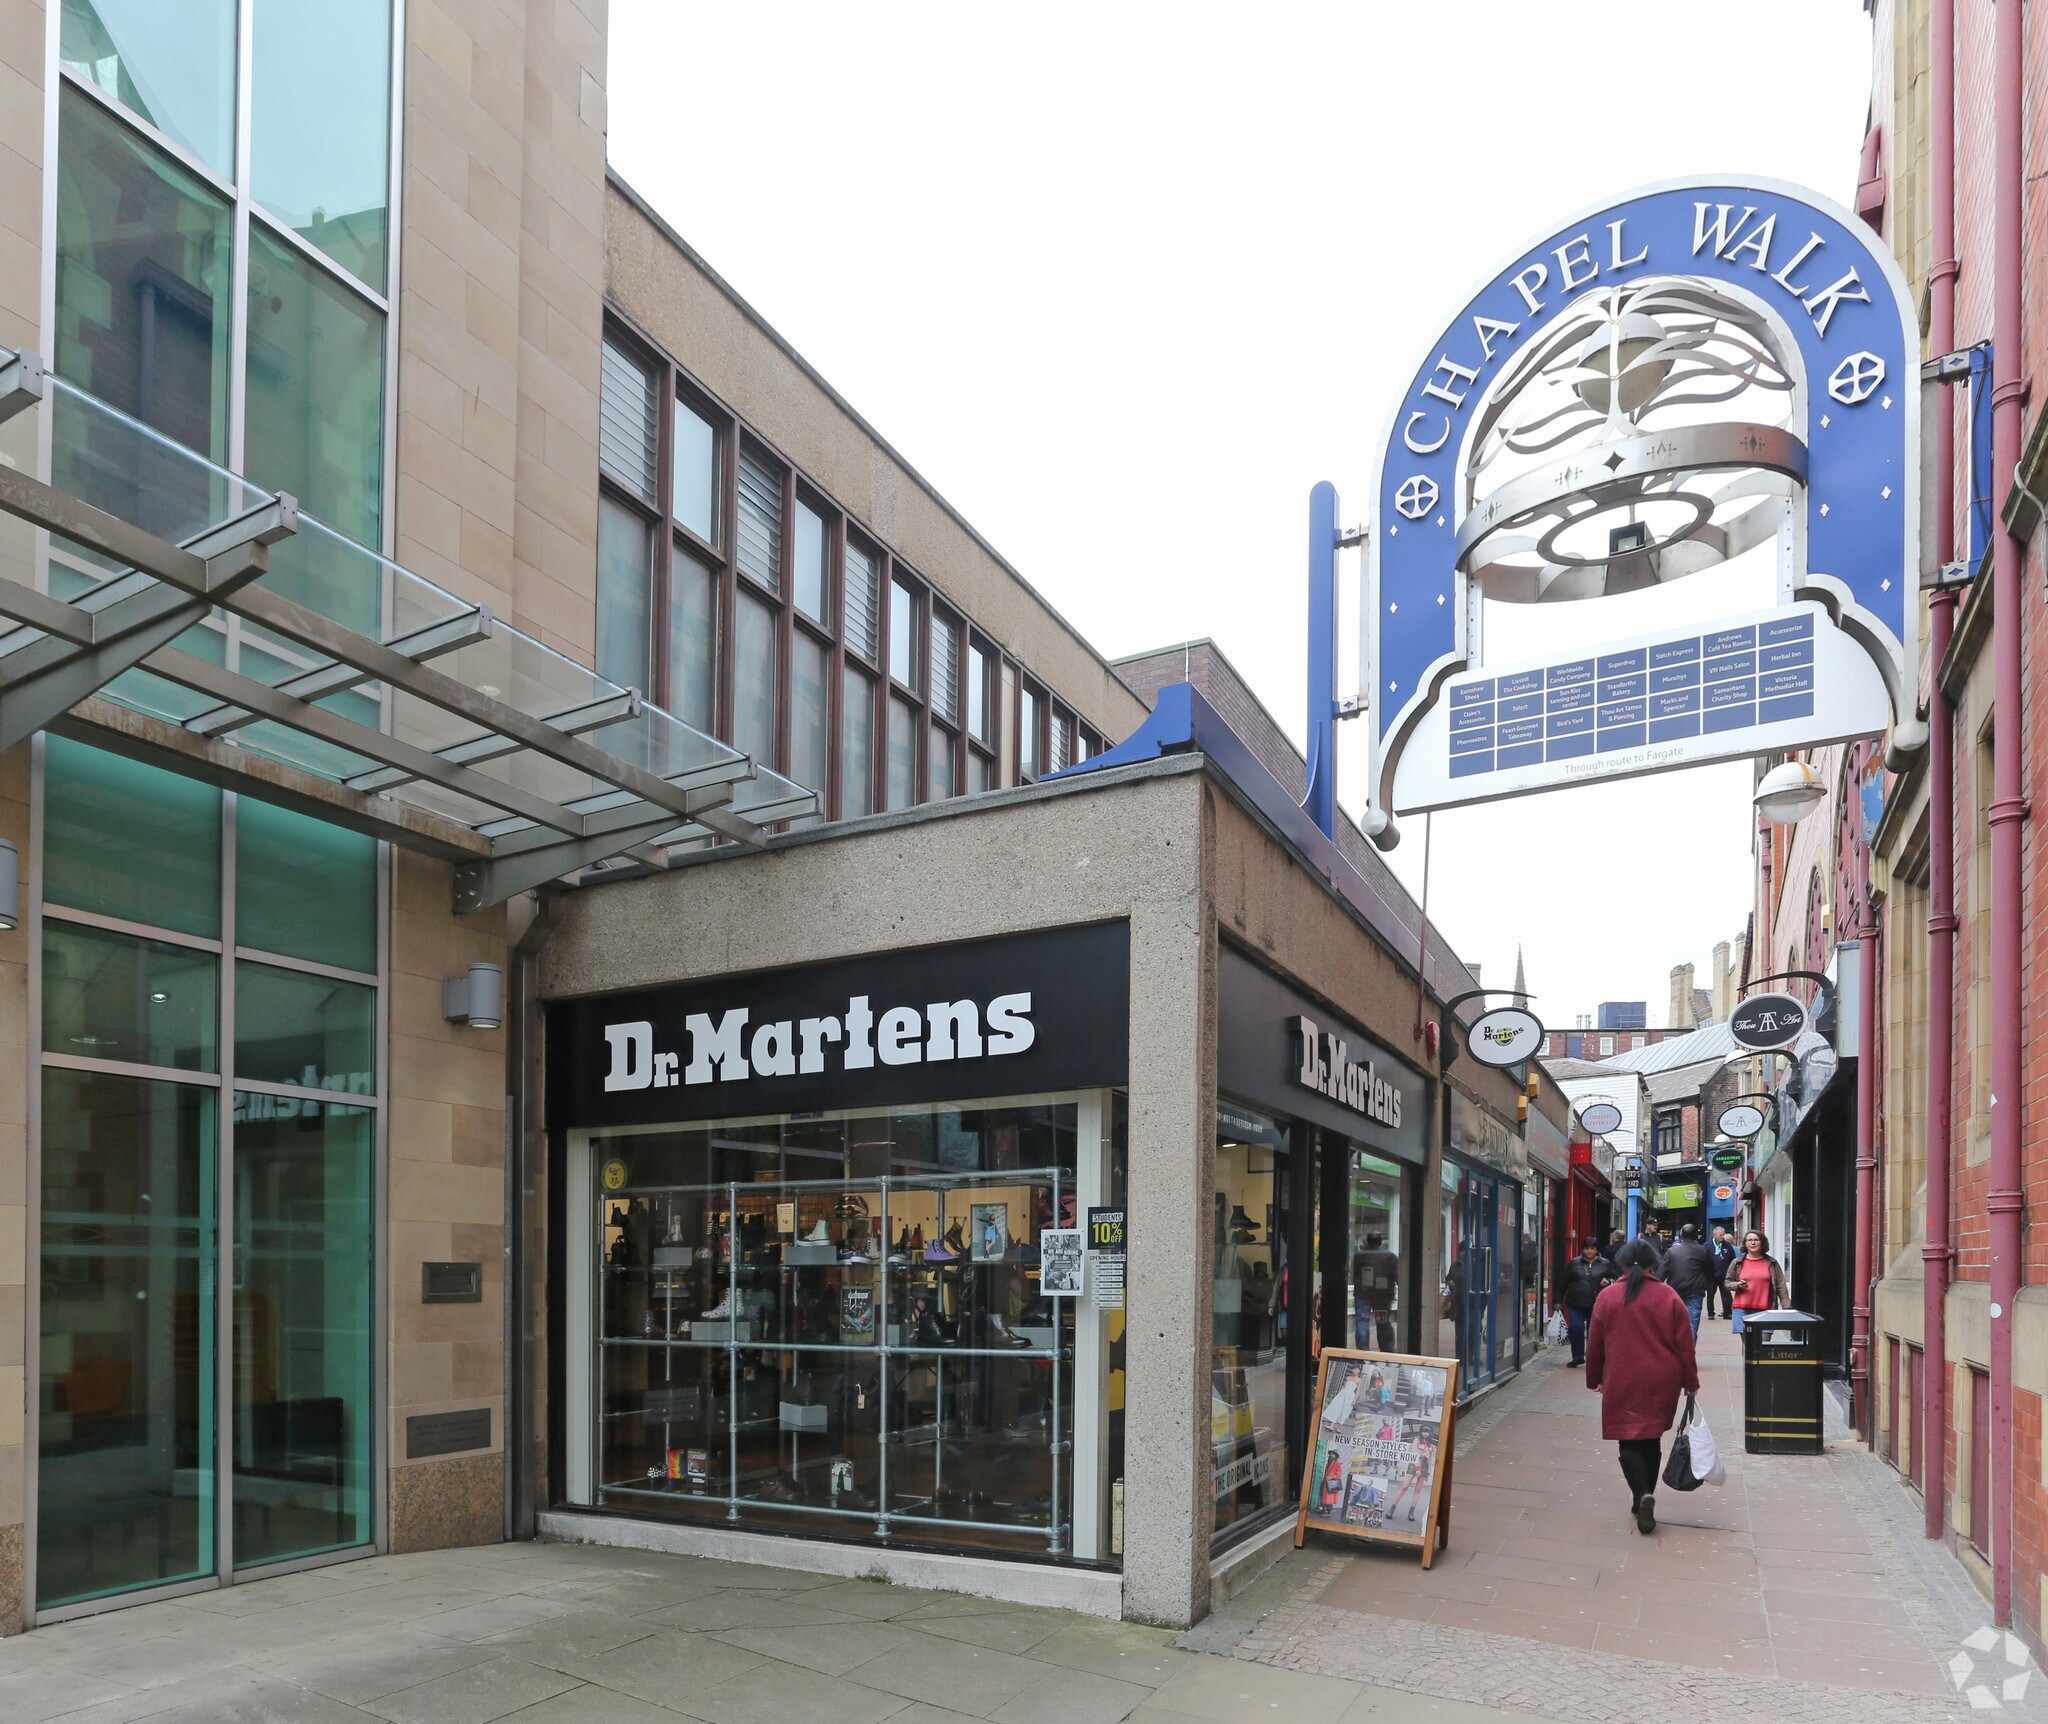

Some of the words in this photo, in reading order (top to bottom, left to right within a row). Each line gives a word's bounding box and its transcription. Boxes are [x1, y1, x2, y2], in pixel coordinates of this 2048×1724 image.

[1403, 217, 1650, 454] CHAPEL
[1691, 201, 1872, 340] WALK
[1769, 625, 1803, 636] Accessorize
[1717, 634, 1742, 643] Andrews
[1732, 639, 1752, 647] Rooms
[1656, 651, 1672, 660] Stitch
[1673, 648, 1694, 657] Express
[1771, 653, 1791, 662] Herbal
[1608, 659, 1636, 669] Superdrug
[1719, 664, 1733, 672] Nails
[1734, 661, 1750, 669] Salon
[1557, 666, 1584, 675] Worldwide
[1549, 676, 1566, 684] Candy
[1567, 672, 1591, 681] Company
[1662, 674, 1687, 683] Munchys
[1774, 674, 1797, 684] Victoria
[1513, 682, 1538, 692] Cookshop
[1607, 680, 1636, 690] Staniforths
[1713, 684, 1745, 695] Samaritans
[1764, 682, 1794, 693] Methodist
[1612, 689, 1631, 697] Bakery
[1711, 694, 1732, 703] Charity
[1732, 691, 1748, 700] Shop
[1660, 697, 1677, 705] Marks
[1512, 704, 1528, 712] Select
[1601, 708, 1615, 716] Thou
[1624, 704, 1642, 712] Tattoo
[1663, 703, 1686, 713] Spencer
[1463, 710, 1481, 718] Claire's
[1613, 713, 1635, 722] Piercing
[1458, 716, 1486, 725] Accessories
[1557, 719, 1571, 727] Bird's
[1572, 717, 1584, 725] Yard
[1502, 726, 1516, 734] Feast
[1516, 723, 1539, 731] Gourmet
[1456, 735, 1487, 746] Phoneextras
[1508, 731, 1532, 740] Takeaway
[1565, 761, 1604, 774] Through
[1606, 756, 1632, 768] route
[1634, 753, 1645, 763] to
[1647, 746, 1684, 761] Fargate
[1483, 1027, 1525, 1041] Martens
[1093, 1213, 1123, 1222] STUDENTS
[1110, 1235, 1123, 1243] OFF
[1770, 1347, 1798, 1359] Litter
[1334, 1435, 1351, 1445] NEW
[1352, 1437, 1380, 1448] SEASON
[1381, 1441, 1407, 1452] STYLES
[1364, 1448, 1398, 1460] IN-STORE
[1399, 1453, 1417, 1462] NOW
[1215, 1472, 1225, 1494] THE
[1226, 1459, 1251, 1487] ORIGINAL
